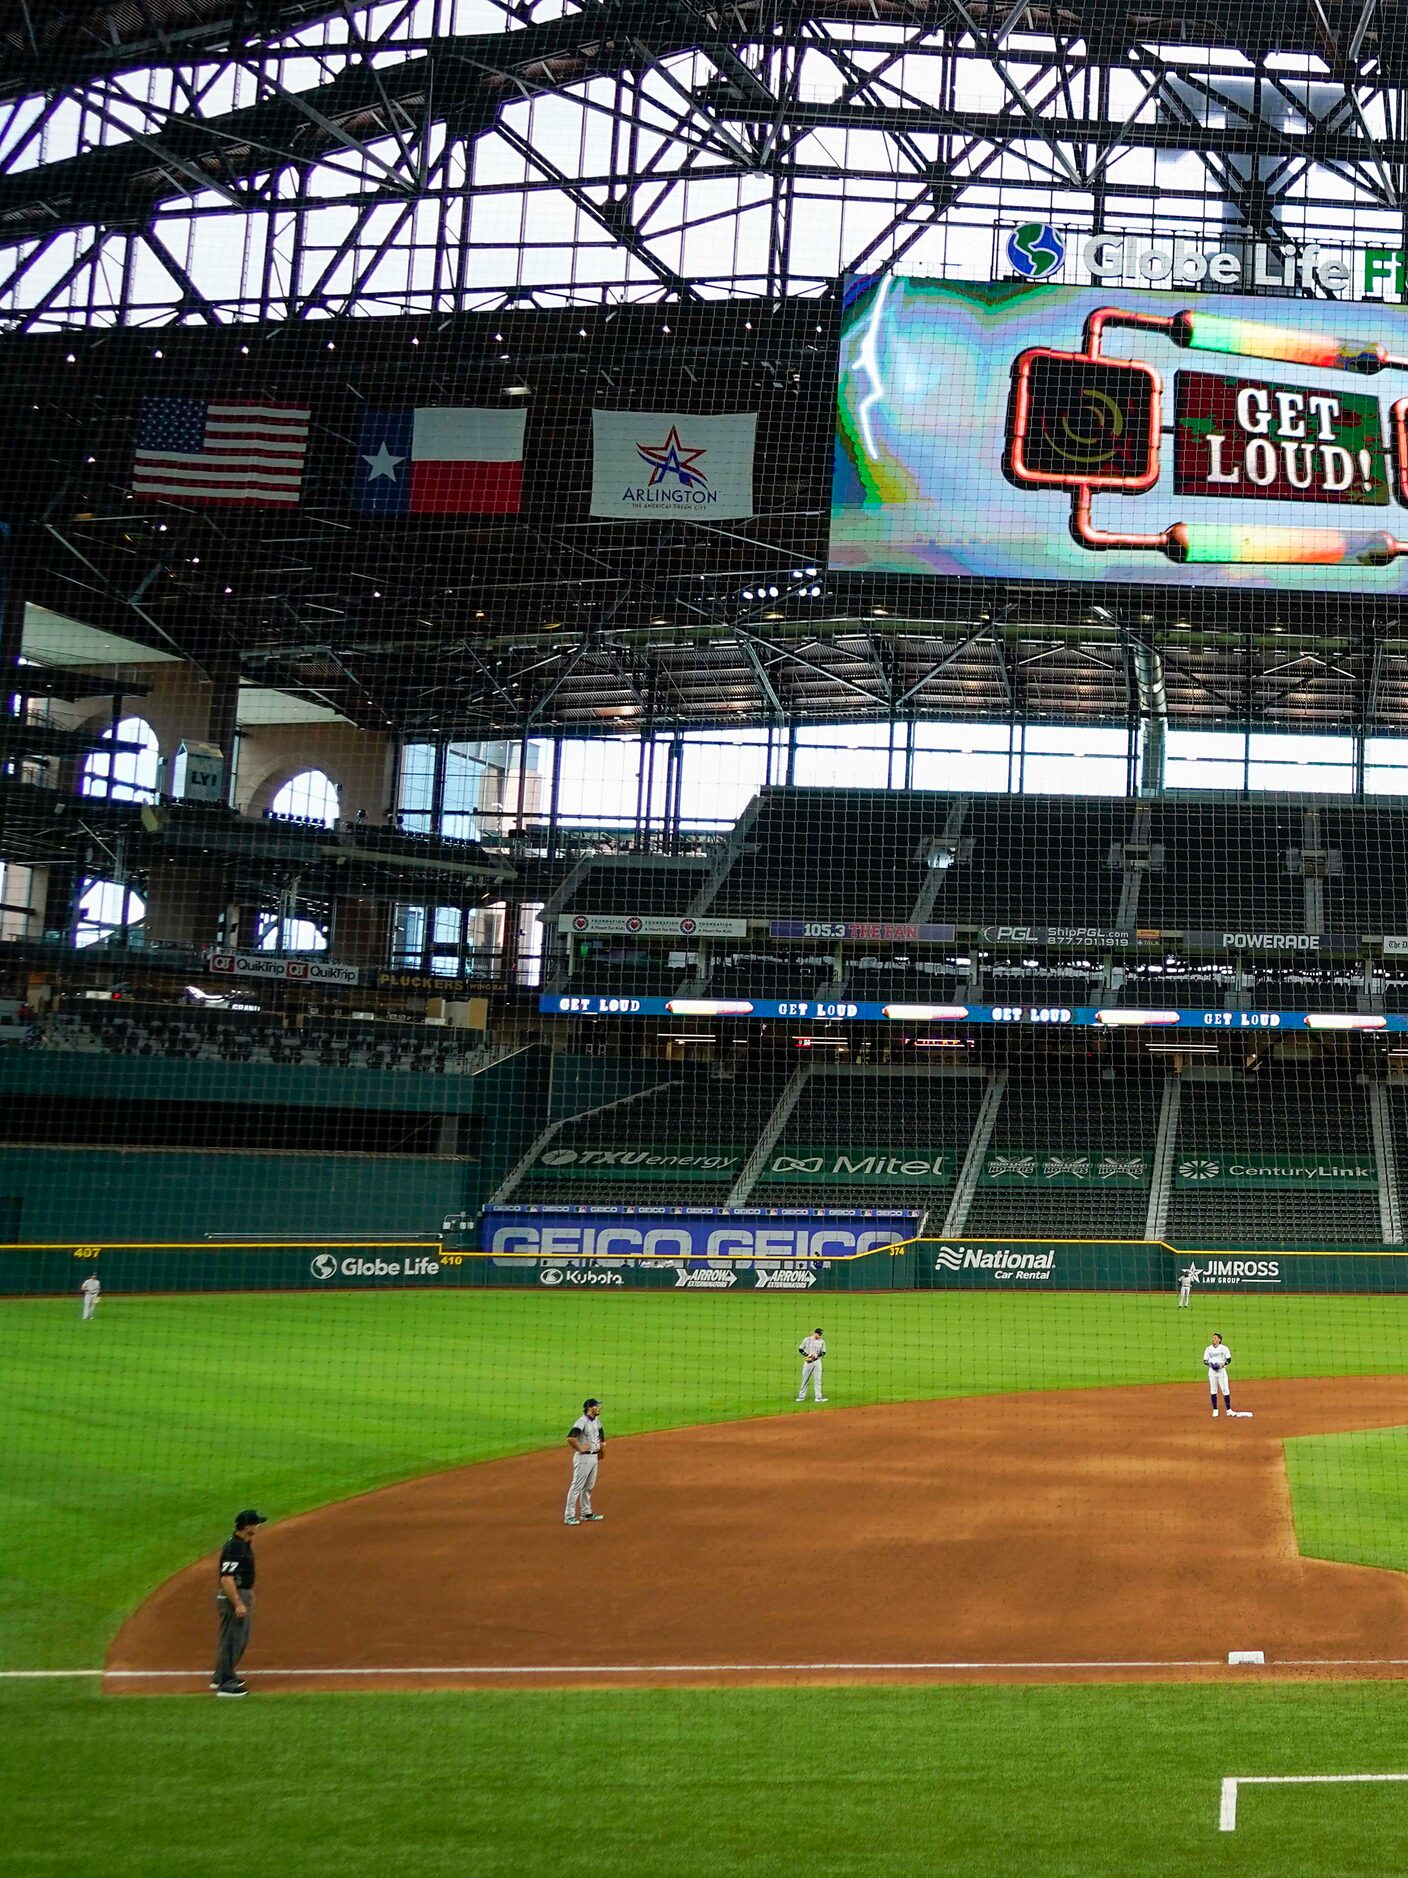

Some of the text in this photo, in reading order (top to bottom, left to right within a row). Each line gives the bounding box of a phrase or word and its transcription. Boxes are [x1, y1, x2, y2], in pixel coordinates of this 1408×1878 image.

[1083, 234, 1241, 285] Globe
[1255, 243, 1350, 292] Life
[1237, 387, 1341, 441] GET
[1205, 434, 1372, 493] LOUD!
[622, 485, 718, 504] ARLINGTON
[803, 924, 919, 939] 105.3 THE FAN
[997, 927, 1039, 941] PGL
[1047, 927, 1129, 938] ShipPGL.com
[1047, 937, 1129, 947] 877.701.1919
[1222, 933, 1320, 950] POWERADE
[1388, 940, 1401, 949] The
[213, 957, 231, 969] QT
[236, 958, 285, 975] QuikTrip
[288, 964, 306, 976] QT
[310, 965, 356, 981] QuikTrip
[380, 973, 465, 991] PLUCKERS
[559, 998, 641, 1012] GET LOUD
[778, 1003, 858, 1017] GET LOUD
[992, 1008, 1072, 1022] GET LOUD
[1204, 1013, 1281, 1027] GET LOUD
[831, 1156, 943, 1176] Mitel
[1229, 1165, 1369, 1179] CenturyLink
[73, 1248, 101, 1259] 407
[492, 1226, 693, 1269] GEICO
[706, 1229, 905, 1270] GEICO
[889, 1247, 905, 1257] 374
[440, 1255, 463, 1266] 410
[963, 1248, 1053, 1269] National
[341, 1257, 439, 1276] Globe Life
[566, 1270, 622, 1284] Kubota
[690, 1269, 727, 1281] ARROW
[771, 1270, 808, 1282] ARROW
[994, 1270, 1050, 1280] Car Rental
[221, 1561, 240, 1573] 77
